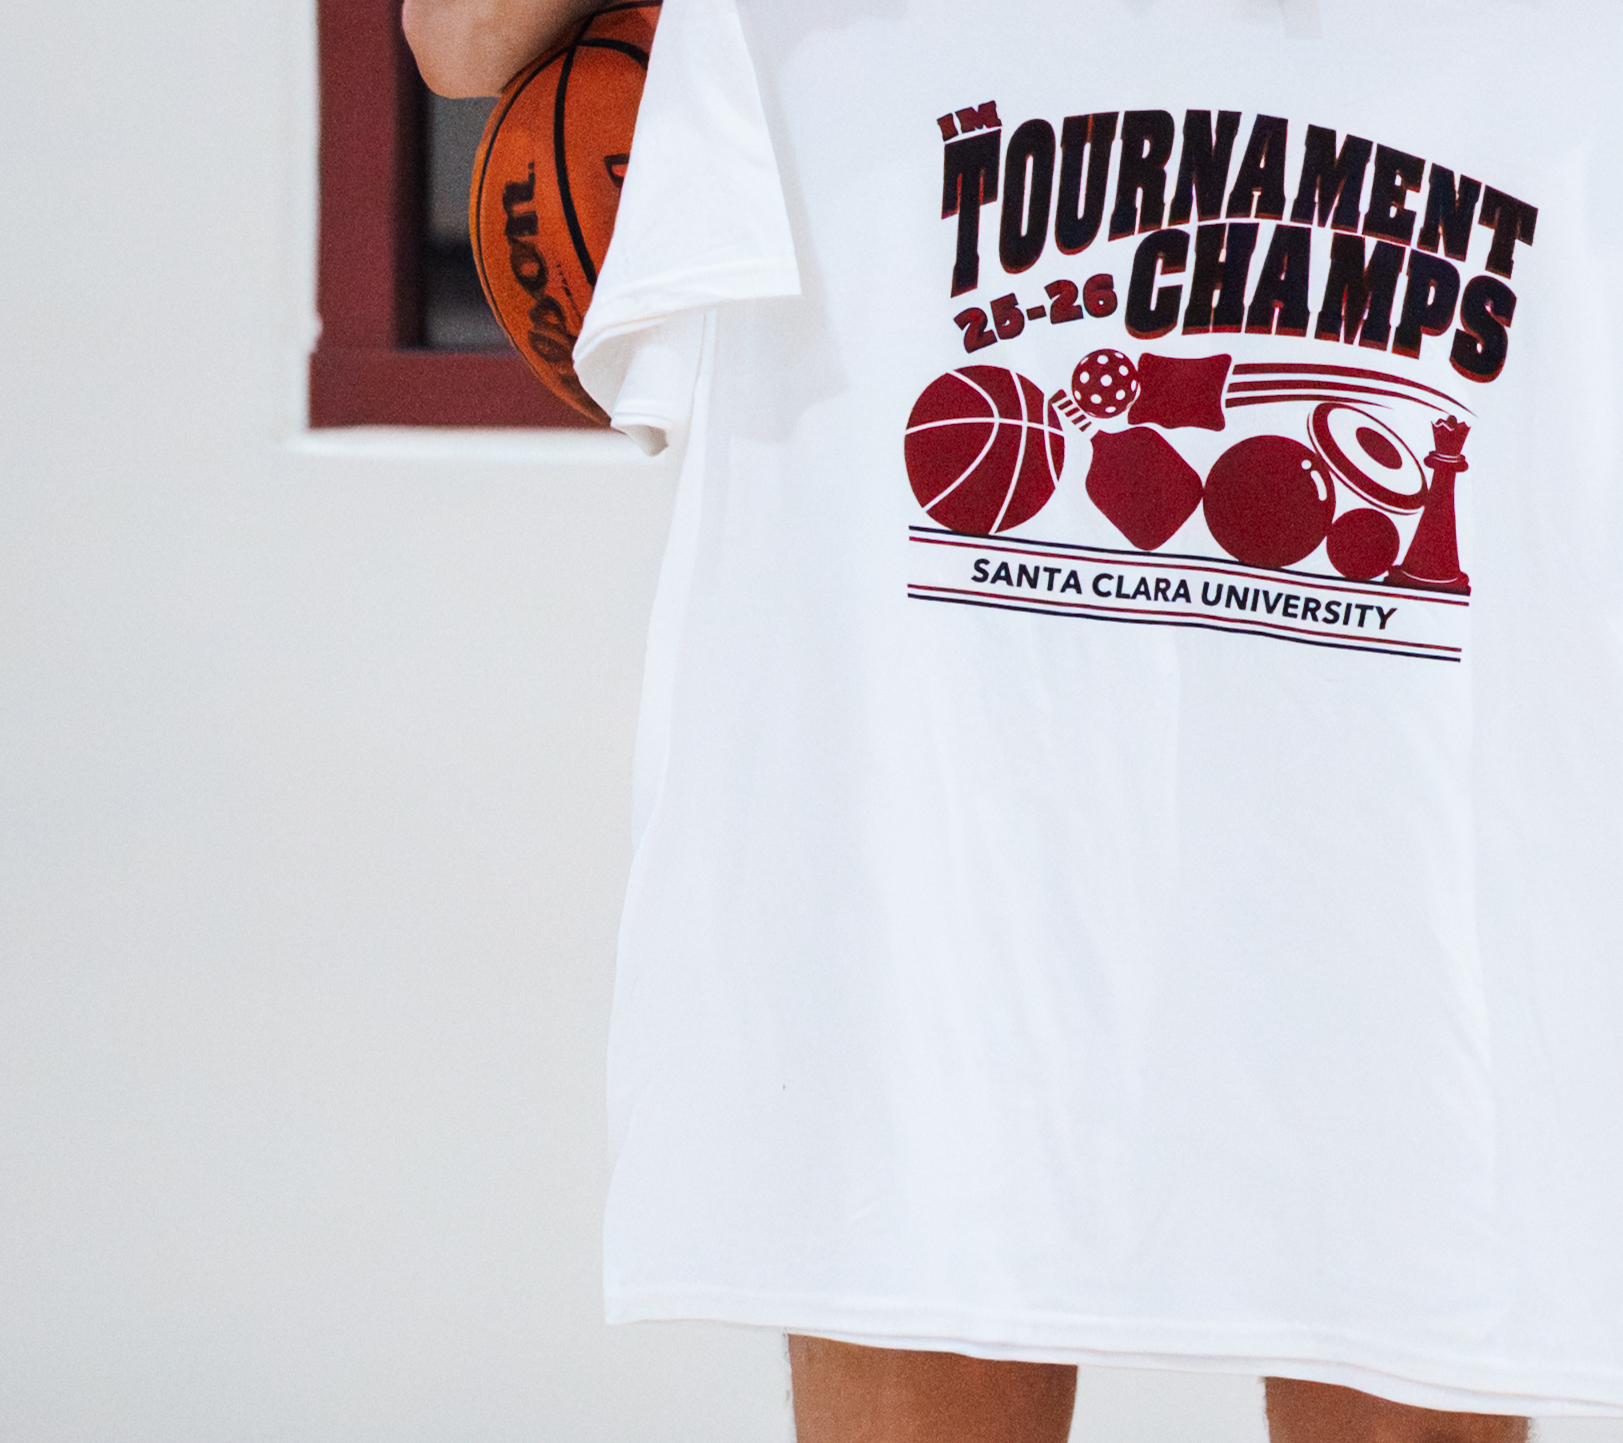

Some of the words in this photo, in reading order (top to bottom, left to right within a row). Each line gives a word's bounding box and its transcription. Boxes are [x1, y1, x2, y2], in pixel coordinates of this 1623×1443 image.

[937, 100, 1002, 141] IM
[941, 109, 1538, 298] TOURNAMENT
[953, 273, 1118, 353] 25-26
[1125, 222, 1517, 383] CHAMPS
[971, 558, 1083, 595] SANTA
[1092, 572, 1192, 604] CLARA
[1200, 583, 1397, 630] UNIVERSITY
